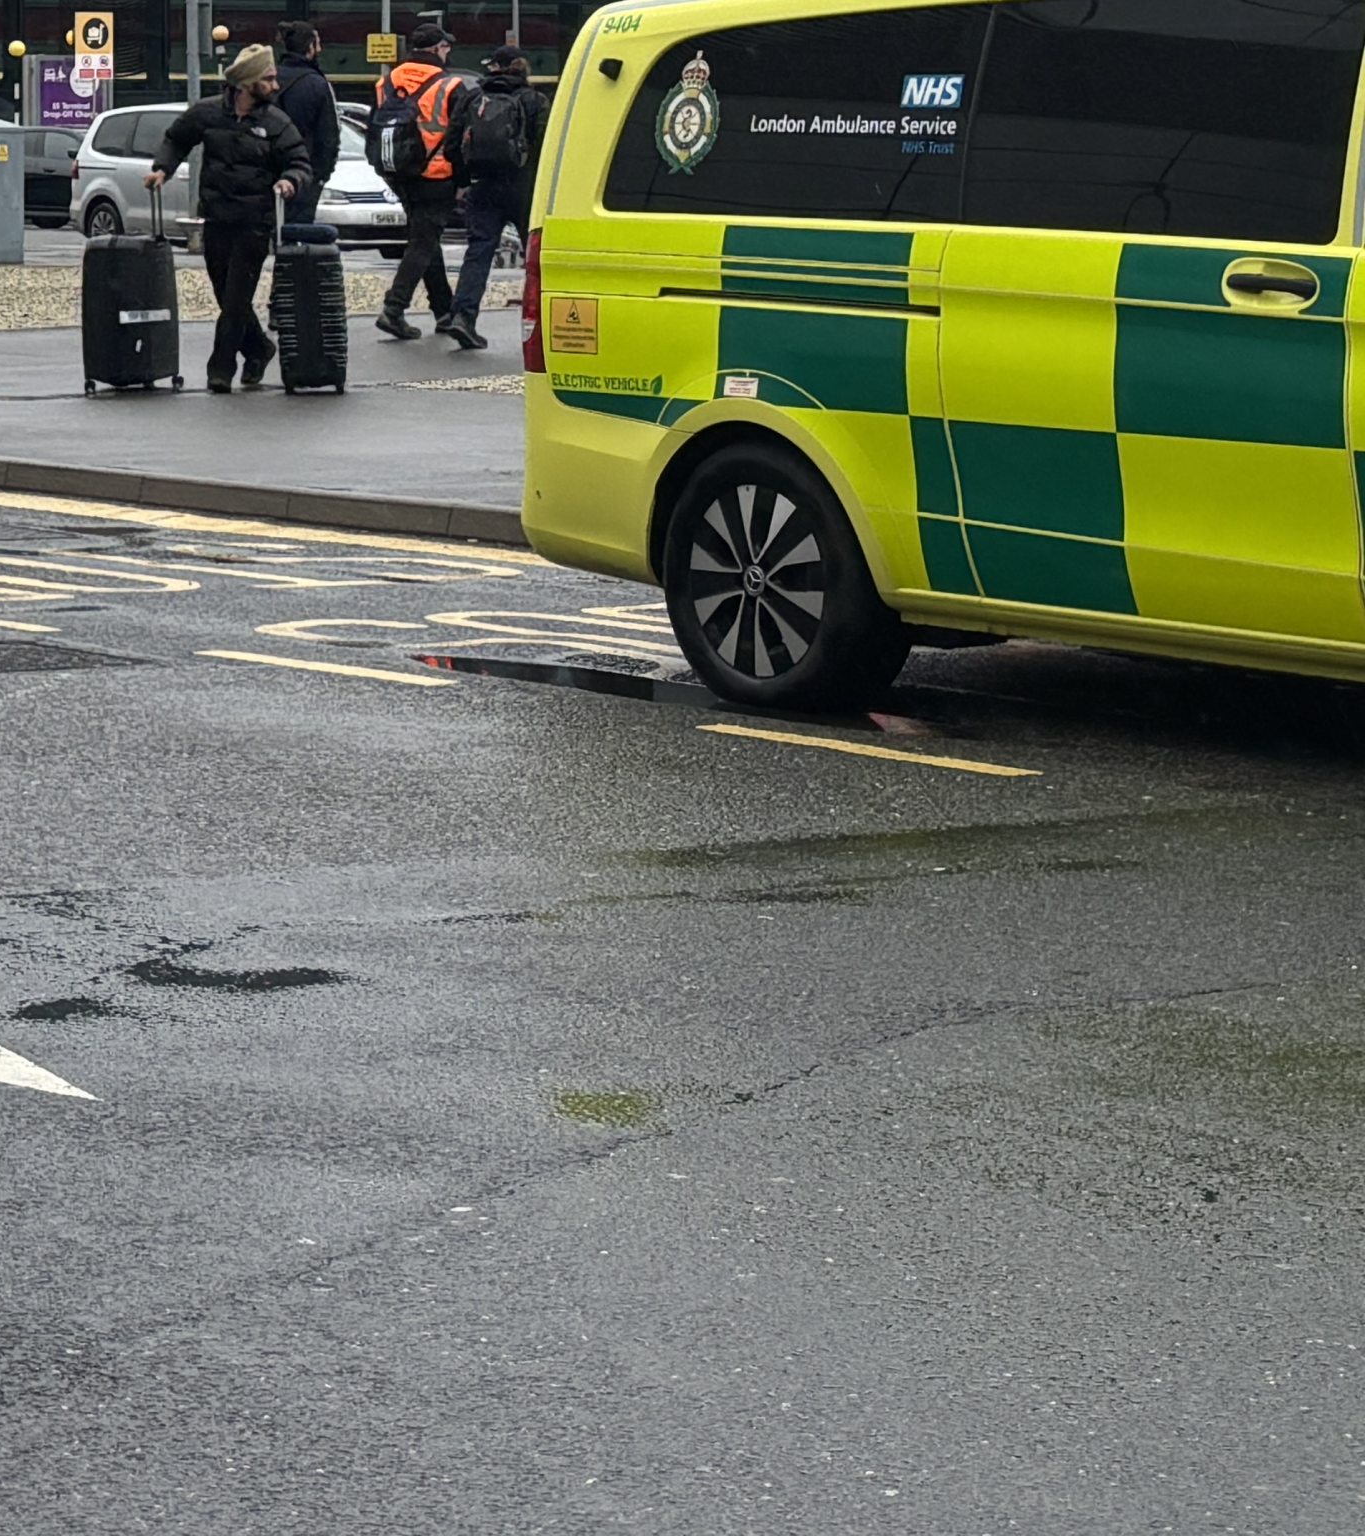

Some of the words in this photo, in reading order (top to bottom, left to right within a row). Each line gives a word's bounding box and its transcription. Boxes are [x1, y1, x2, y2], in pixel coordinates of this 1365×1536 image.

[602, 13, 644, 34] 9404
[901, 76, 963, 107] NHS
[750, 114, 806, 134] London
[809, 114, 897, 135] Ambulance
[899, 115, 957, 136] Service
[901, 140, 926, 154] NHS
[927, 141, 956, 155] Trust
[550, 372, 602, 389] ELECTRIC
[602, 375, 650, 392] VEHICLE
